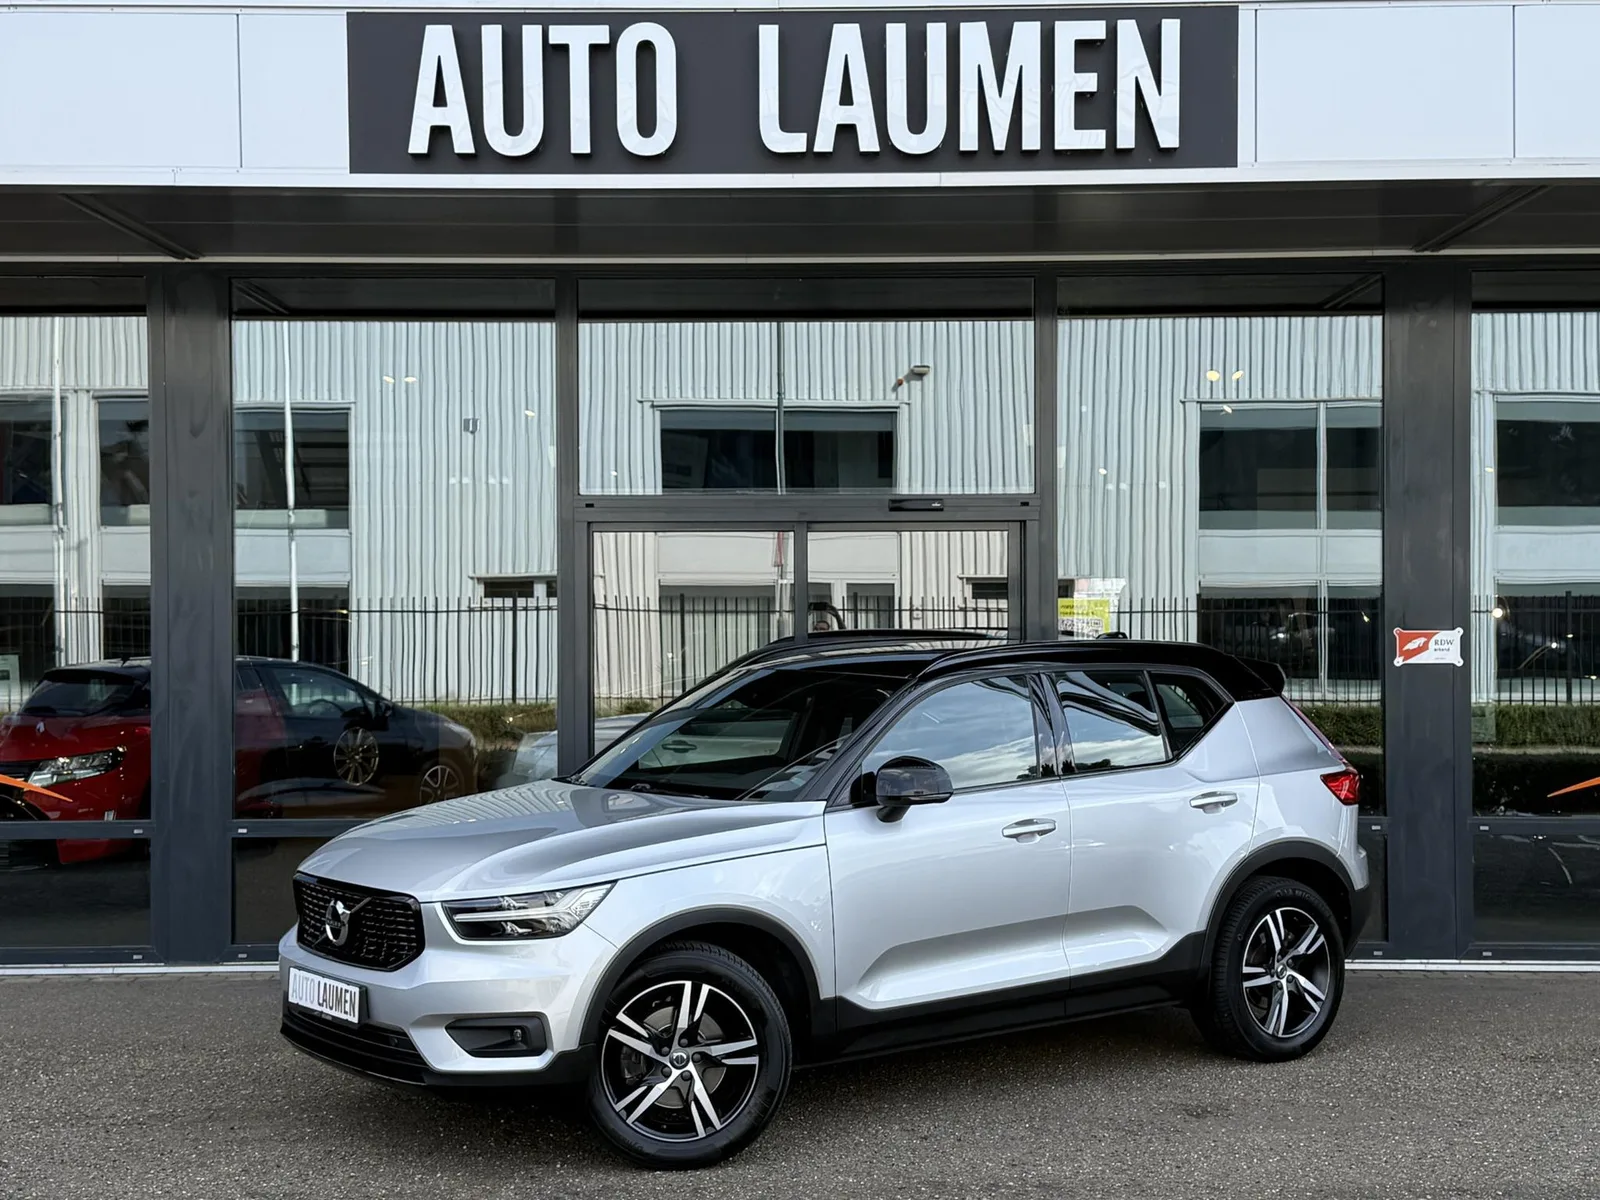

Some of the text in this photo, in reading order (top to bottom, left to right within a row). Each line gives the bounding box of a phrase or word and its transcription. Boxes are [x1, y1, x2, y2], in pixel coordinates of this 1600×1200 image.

[408, 17, 1181, 157] AUTO LAUMEN
[1434, 638, 1455, 646] RDW
[291, 973, 356, 1018] AUTO LAUMEN
